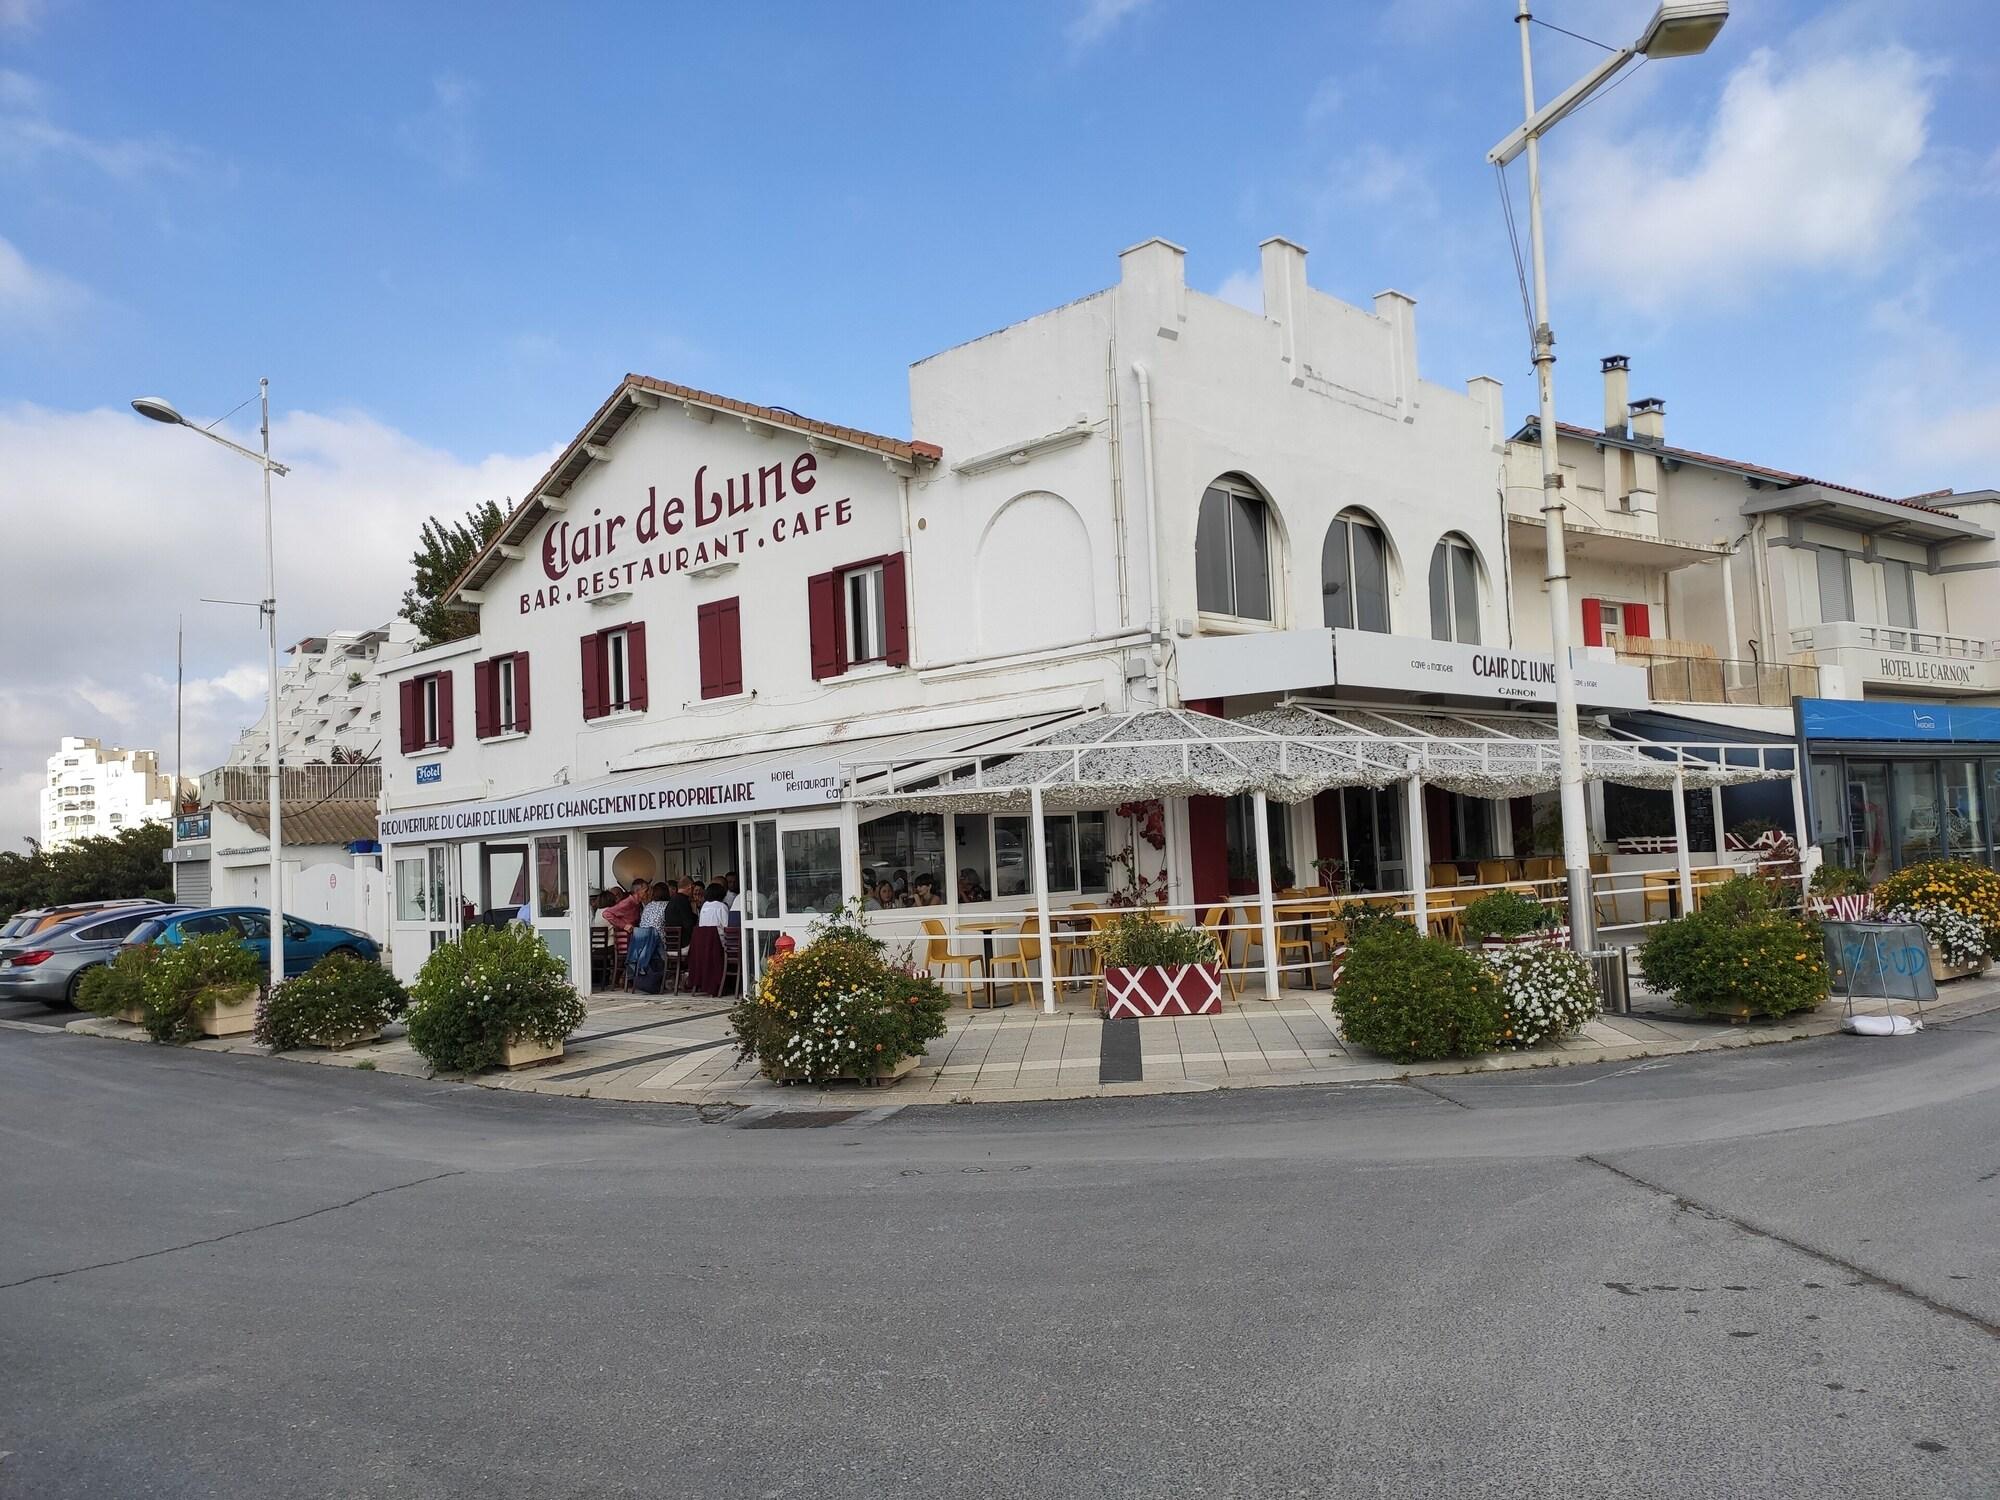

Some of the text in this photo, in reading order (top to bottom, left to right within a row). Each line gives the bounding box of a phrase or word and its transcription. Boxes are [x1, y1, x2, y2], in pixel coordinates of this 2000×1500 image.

[542, 452, 817, 581] Clair de Lune
[772, 497, 852, 543] CAFE
[1473, 654, 1556, 684] CLAIR DE LUNE
[1880, 658, 1970, 682] HOTEL LE CARNON
[1498, 687, 1537, 697] CARNON
[417, 765, 440, 778] Hotel
[381, 782, 755, 836] REOUVERTURE DU CLAIR DE LUNE APRES CHANGEMENT DE PROPRIETAIRE
